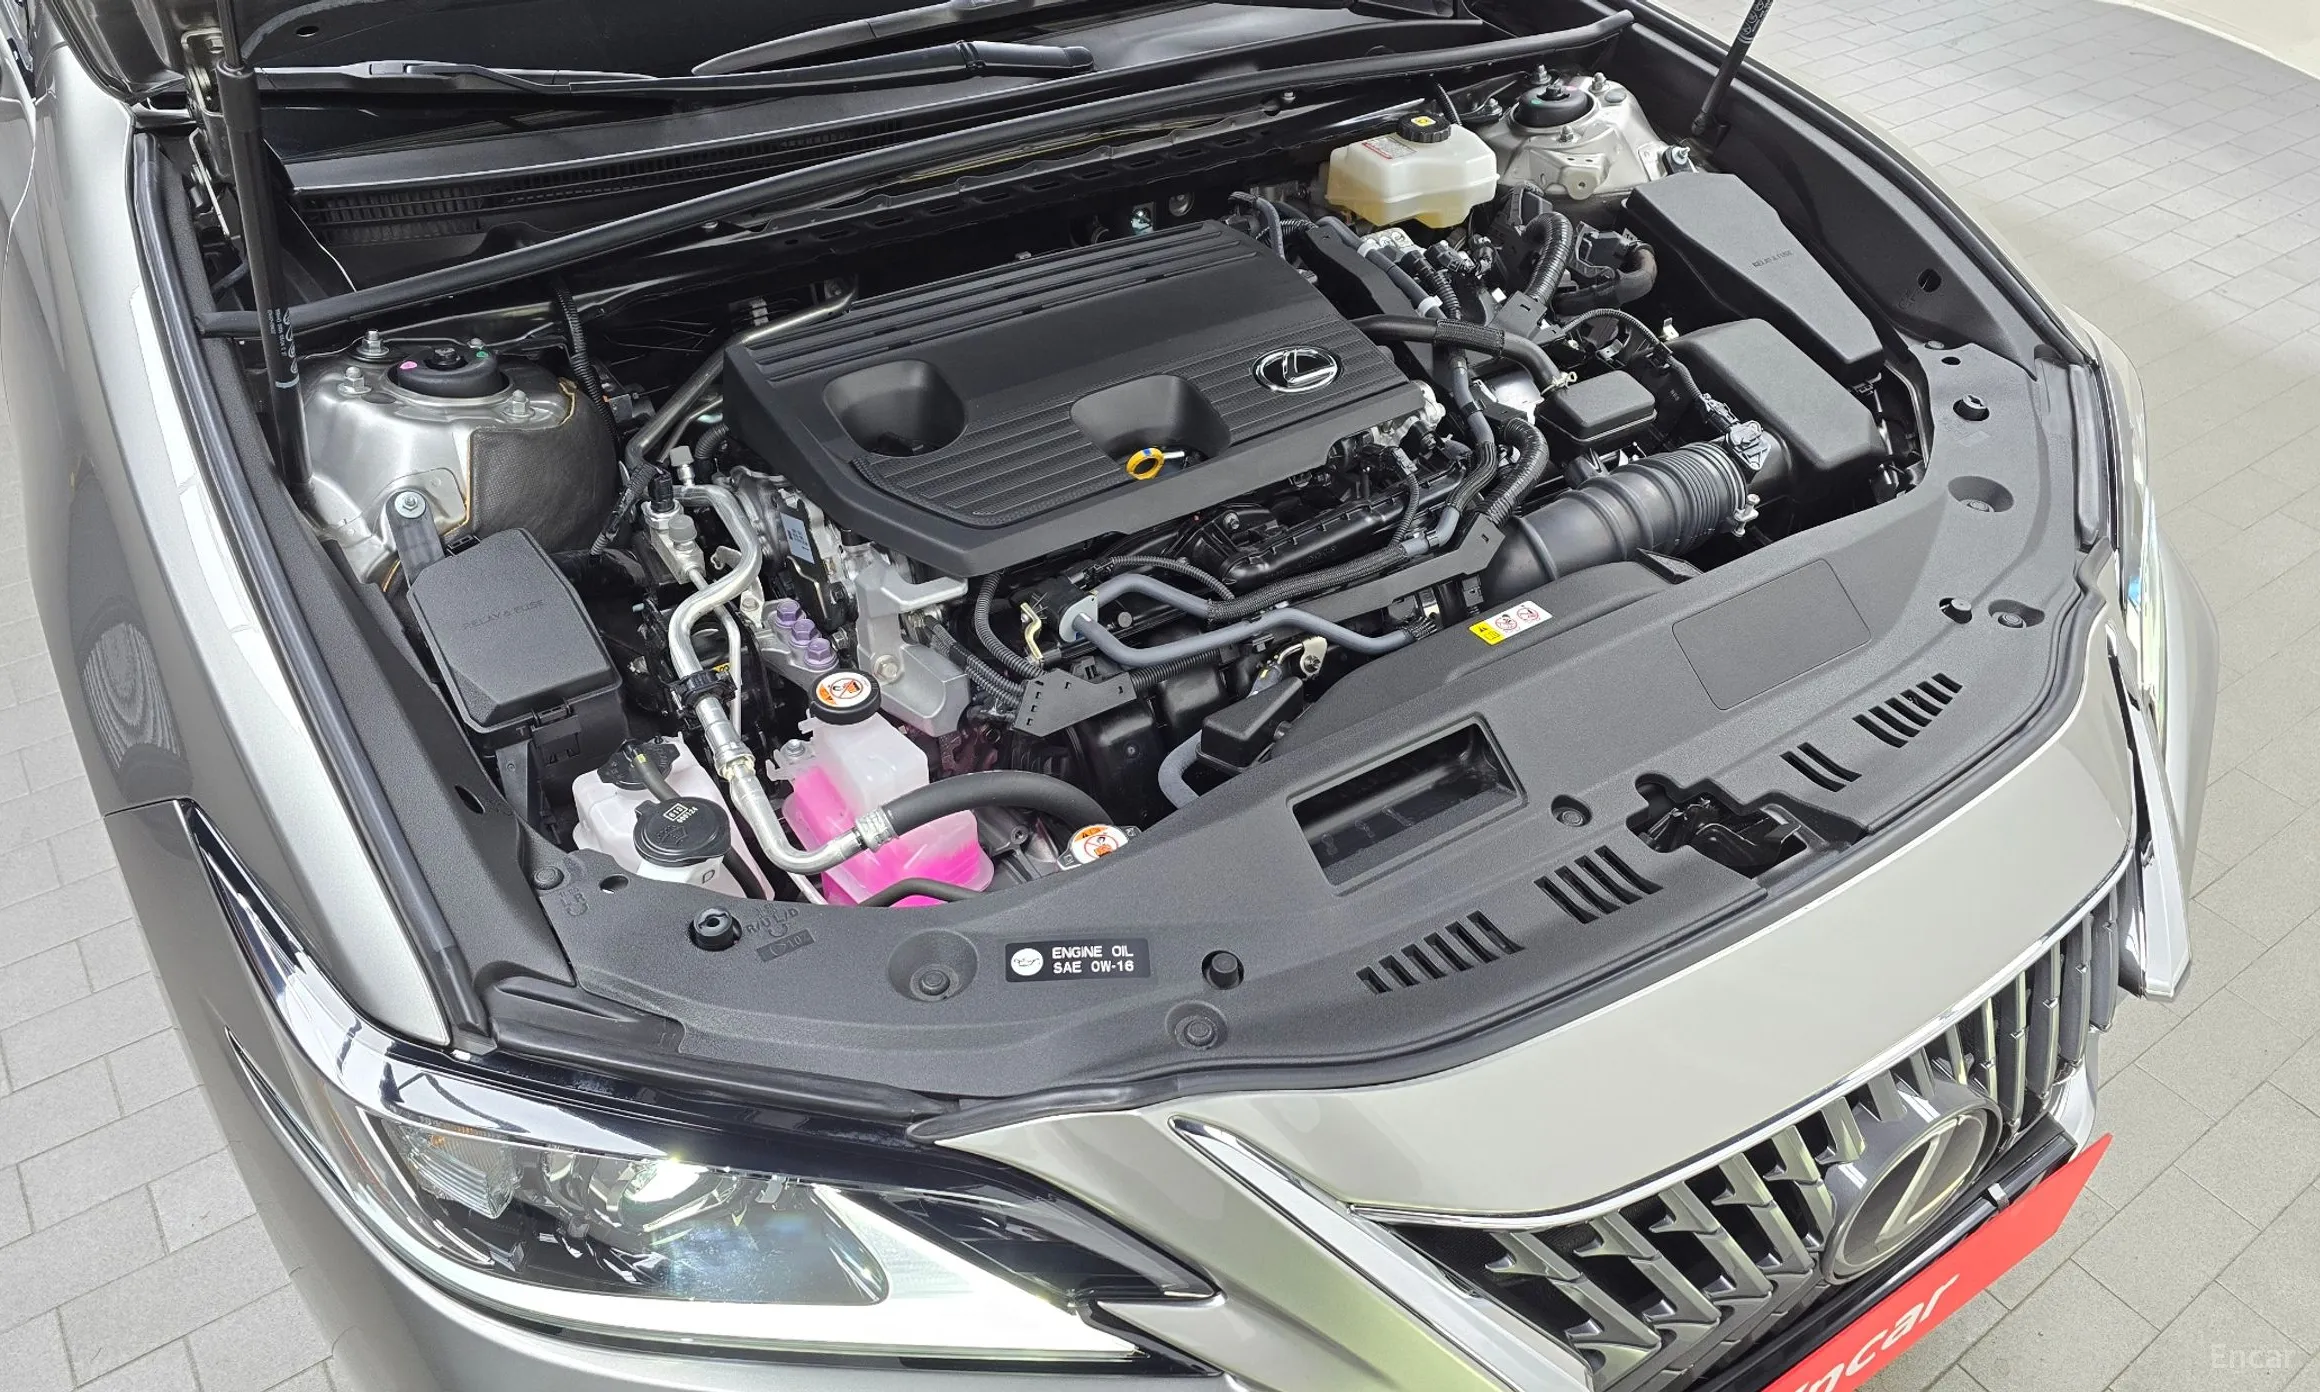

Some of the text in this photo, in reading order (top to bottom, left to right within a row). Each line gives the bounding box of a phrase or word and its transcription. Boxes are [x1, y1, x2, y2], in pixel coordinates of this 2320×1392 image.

[1051, 945, 1134, 960] ENGINE OIL
[1053, 960, 1135, 974] SAE 0W-16
[1795, 1273, 1961, 1392] ncar
